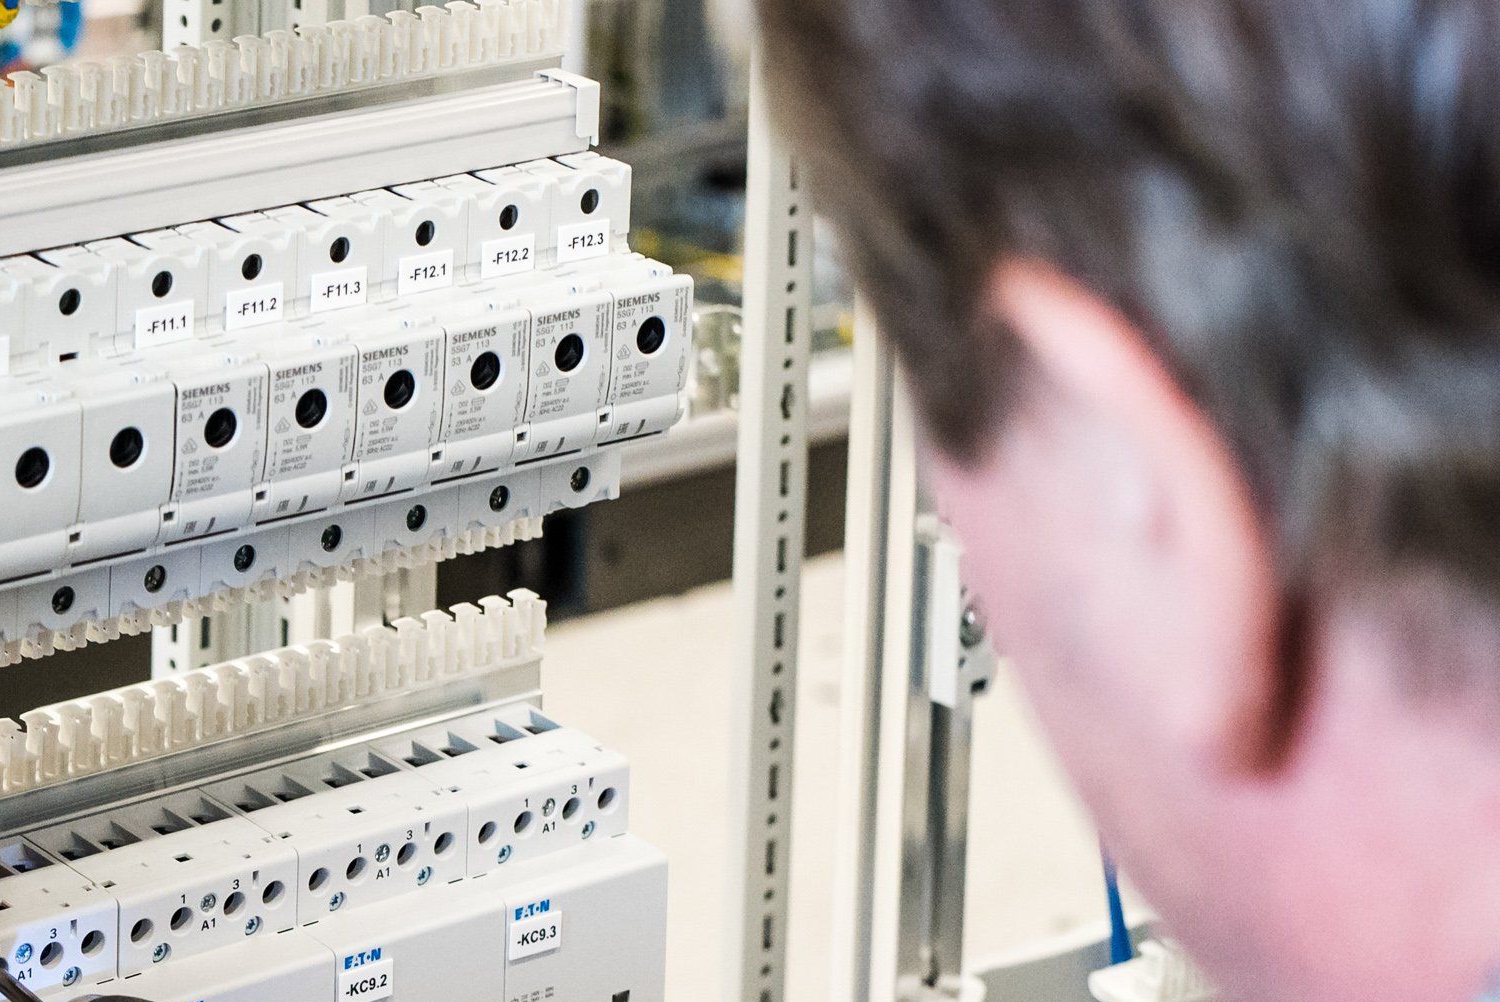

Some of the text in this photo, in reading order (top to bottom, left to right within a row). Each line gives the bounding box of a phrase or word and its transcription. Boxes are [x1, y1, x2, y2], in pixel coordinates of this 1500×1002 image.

[568, 232, 604, 250] -F12.3
[492, 248, 529, 265] -F12.2
[409, 263, 446, 281] -F12.1
[322, 281, 361, 298] -F11.3
[237, 297, 277, 316] -F11.2
[618, 292, 660, 309] SIEMENS
[147, 315, 186, 334] -F11.1
[537, 309, 580, 326] SIEMENS
[452, 327, 496, 344] SIEMENS
[363, 345, 408, 363] SIEMENS
[276, 363, 322, 381] SIEMENS
[182, 383, 230, 399] SIEMENS
[571, 785, 578, 794] 3
[524, 798, 528, 808] 1
[406, 830, 413, 840] 3
[542, 822, 556, 833] A1
[358, 844, 362, 854] 1
[376, 867, 390, 880] A1
[232, 880, 240, 890] 3
[181, 894, 186, 904] 1
[50, 928, 57, 939] 3
[200, 918, 216, 932] A1
[517, 925, 556, 946] -KC9.3
[17, 968, 33, 982] A1
[346, 974, 388, 996] -KC9.2
